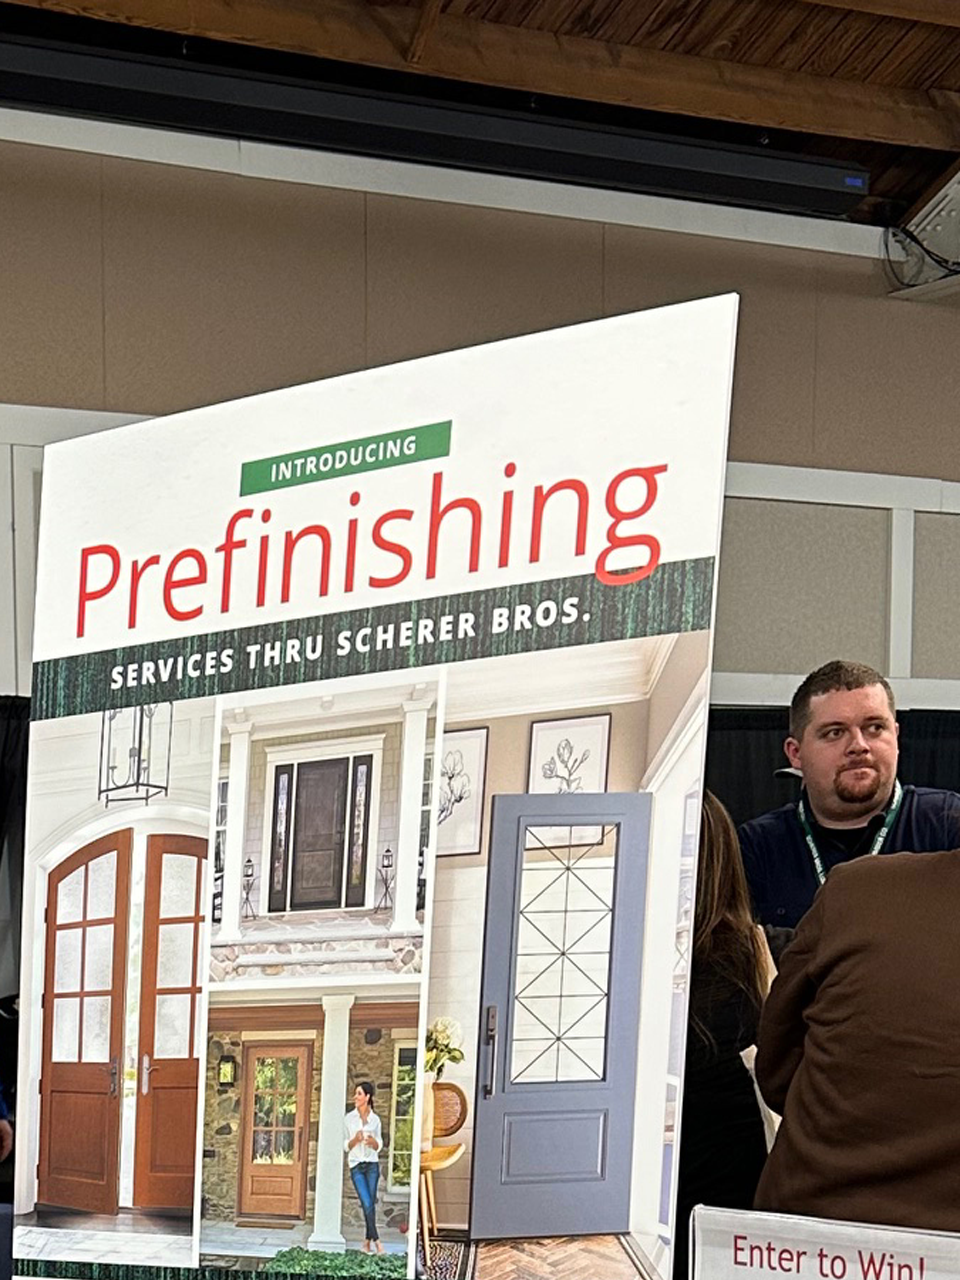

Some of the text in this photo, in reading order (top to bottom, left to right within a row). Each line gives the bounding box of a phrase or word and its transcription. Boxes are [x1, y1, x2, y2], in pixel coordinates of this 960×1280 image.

[271, 435, 417, 482] INTRODUCING
[75, 462, 668, 638] Prefinishing
[111, 597, 591, 690] SERVICES THRU SCHERER BROS.
[734, 1235, 807, 1273] Enter
[818, 1248, 847, 1279] to
